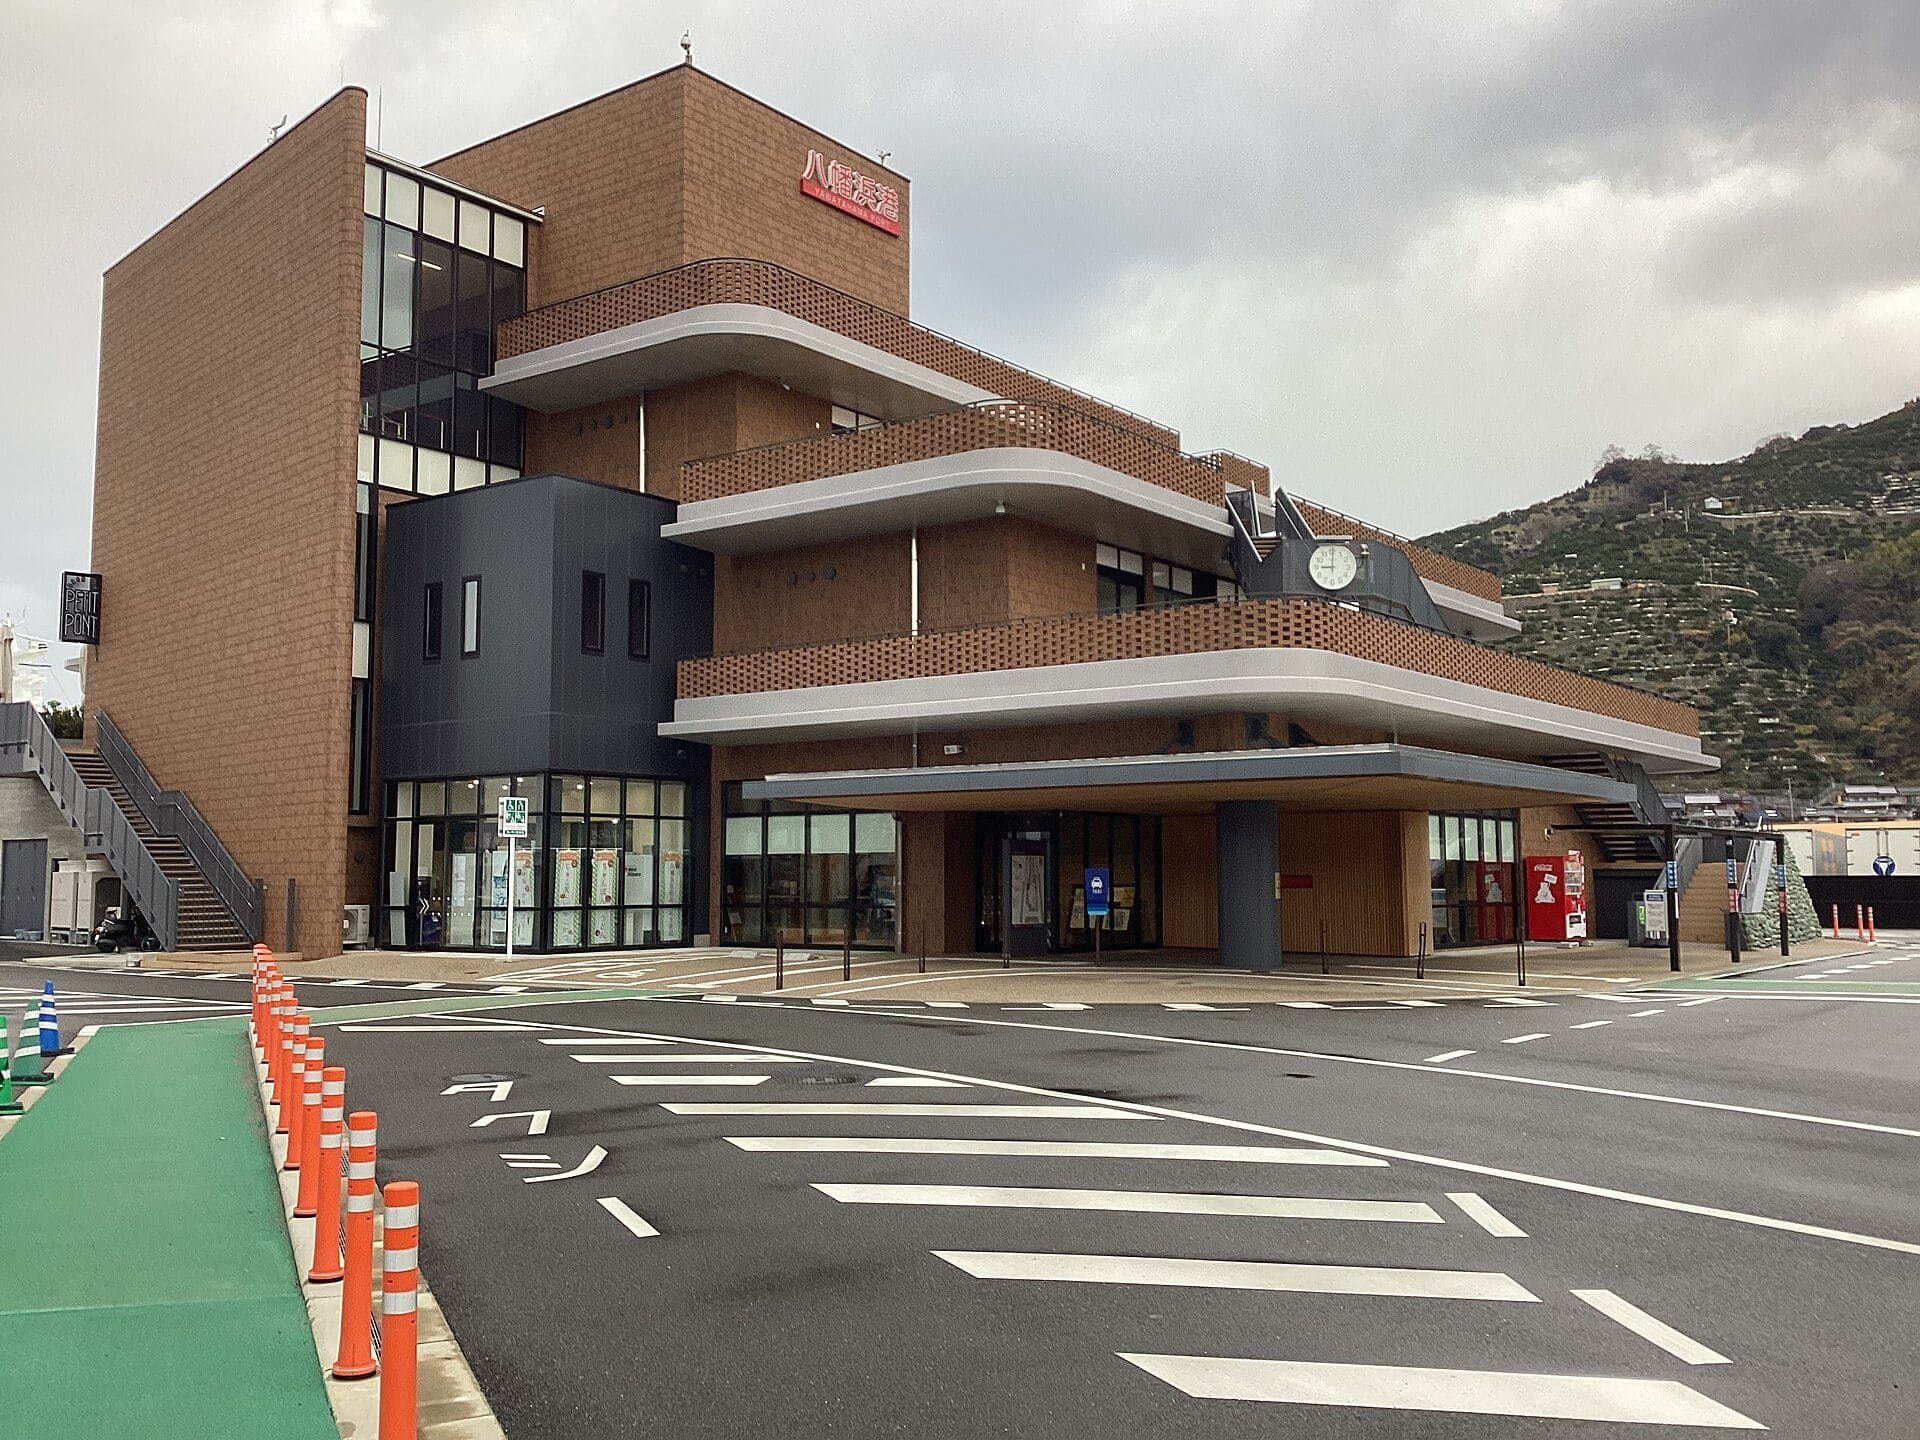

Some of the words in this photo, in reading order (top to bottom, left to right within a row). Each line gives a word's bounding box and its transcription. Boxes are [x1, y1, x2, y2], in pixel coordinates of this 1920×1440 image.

[802, 149, 899, 222] 八幡浜港
[65, 589, 99, 614] PETIT
[64, 613, 98, 638] PONT
